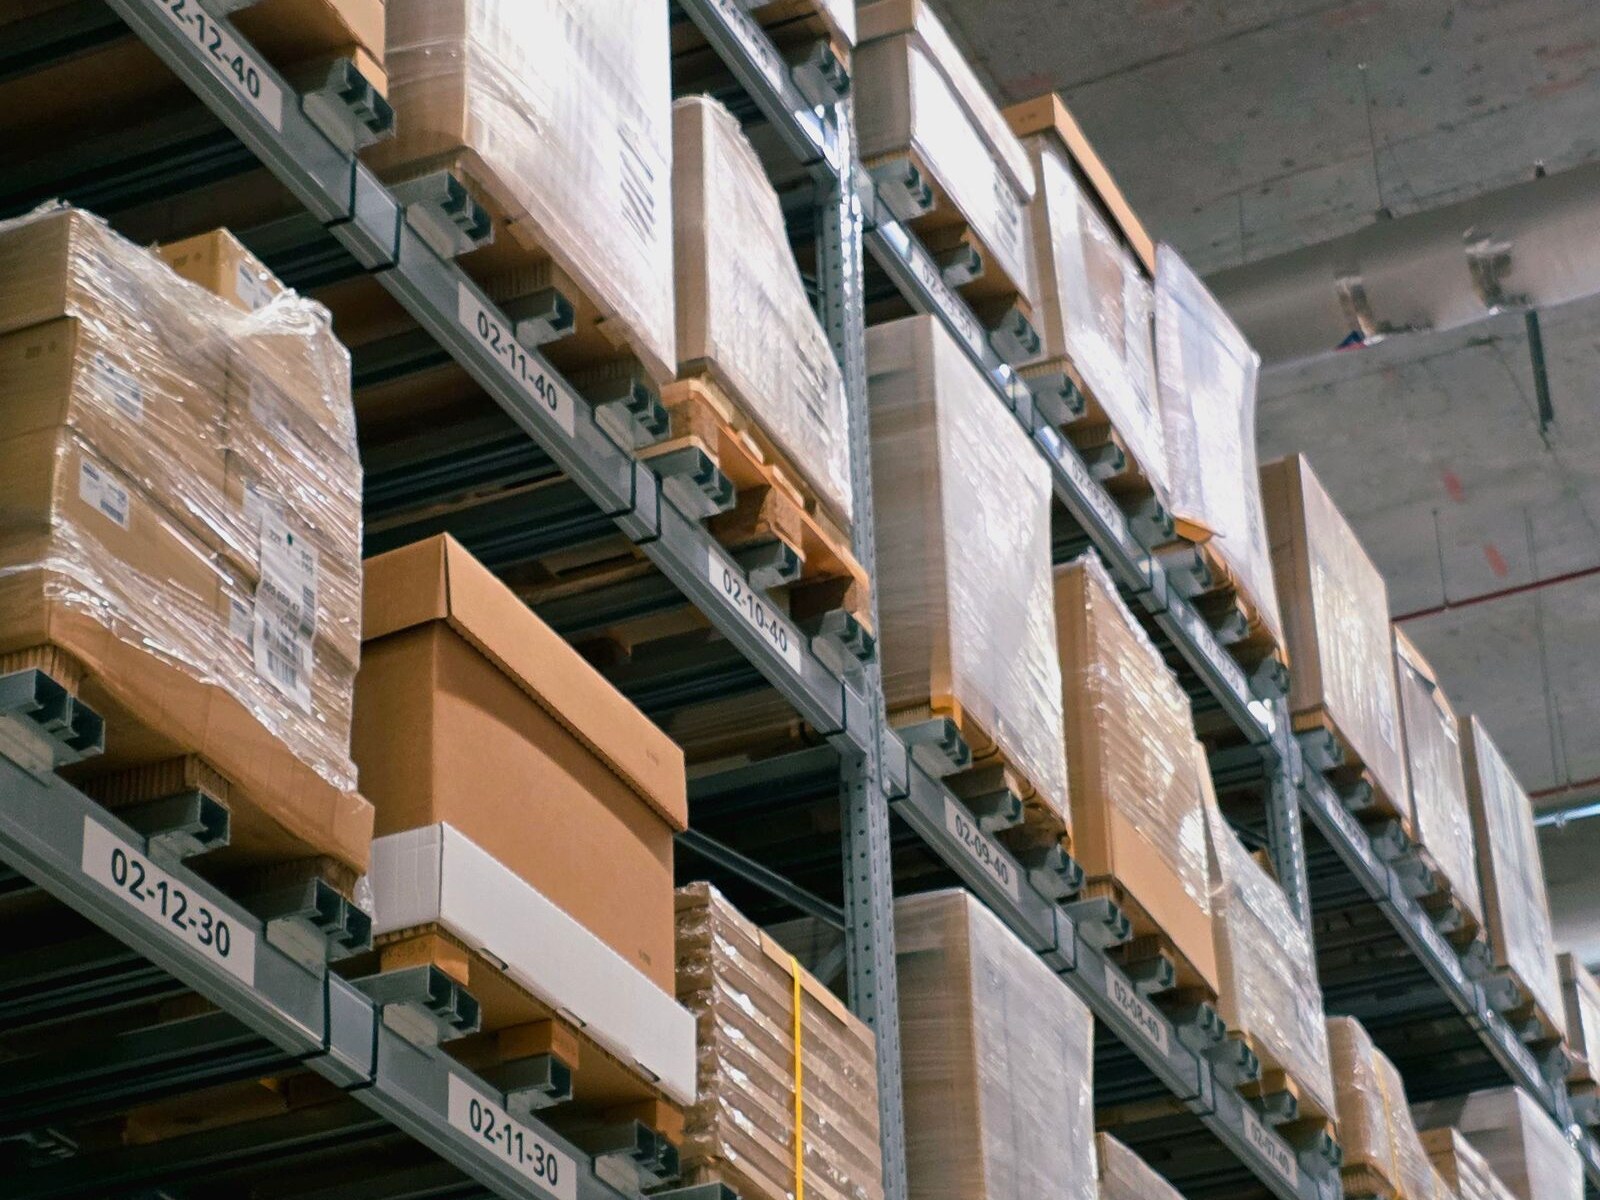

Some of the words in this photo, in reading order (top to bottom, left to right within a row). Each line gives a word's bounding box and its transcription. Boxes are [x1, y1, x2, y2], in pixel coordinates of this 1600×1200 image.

[161, 0, 260, 98] 2-12-40
[478, 310, 559, 411] 02-11-40
[722, 568, 788, 653] 02-10-40
[955, 814, 1009, 885] 02-09-40
[111, 849, 231, 958] 02-12-30
[469, 1098, 559, 1187] 02-11-30
